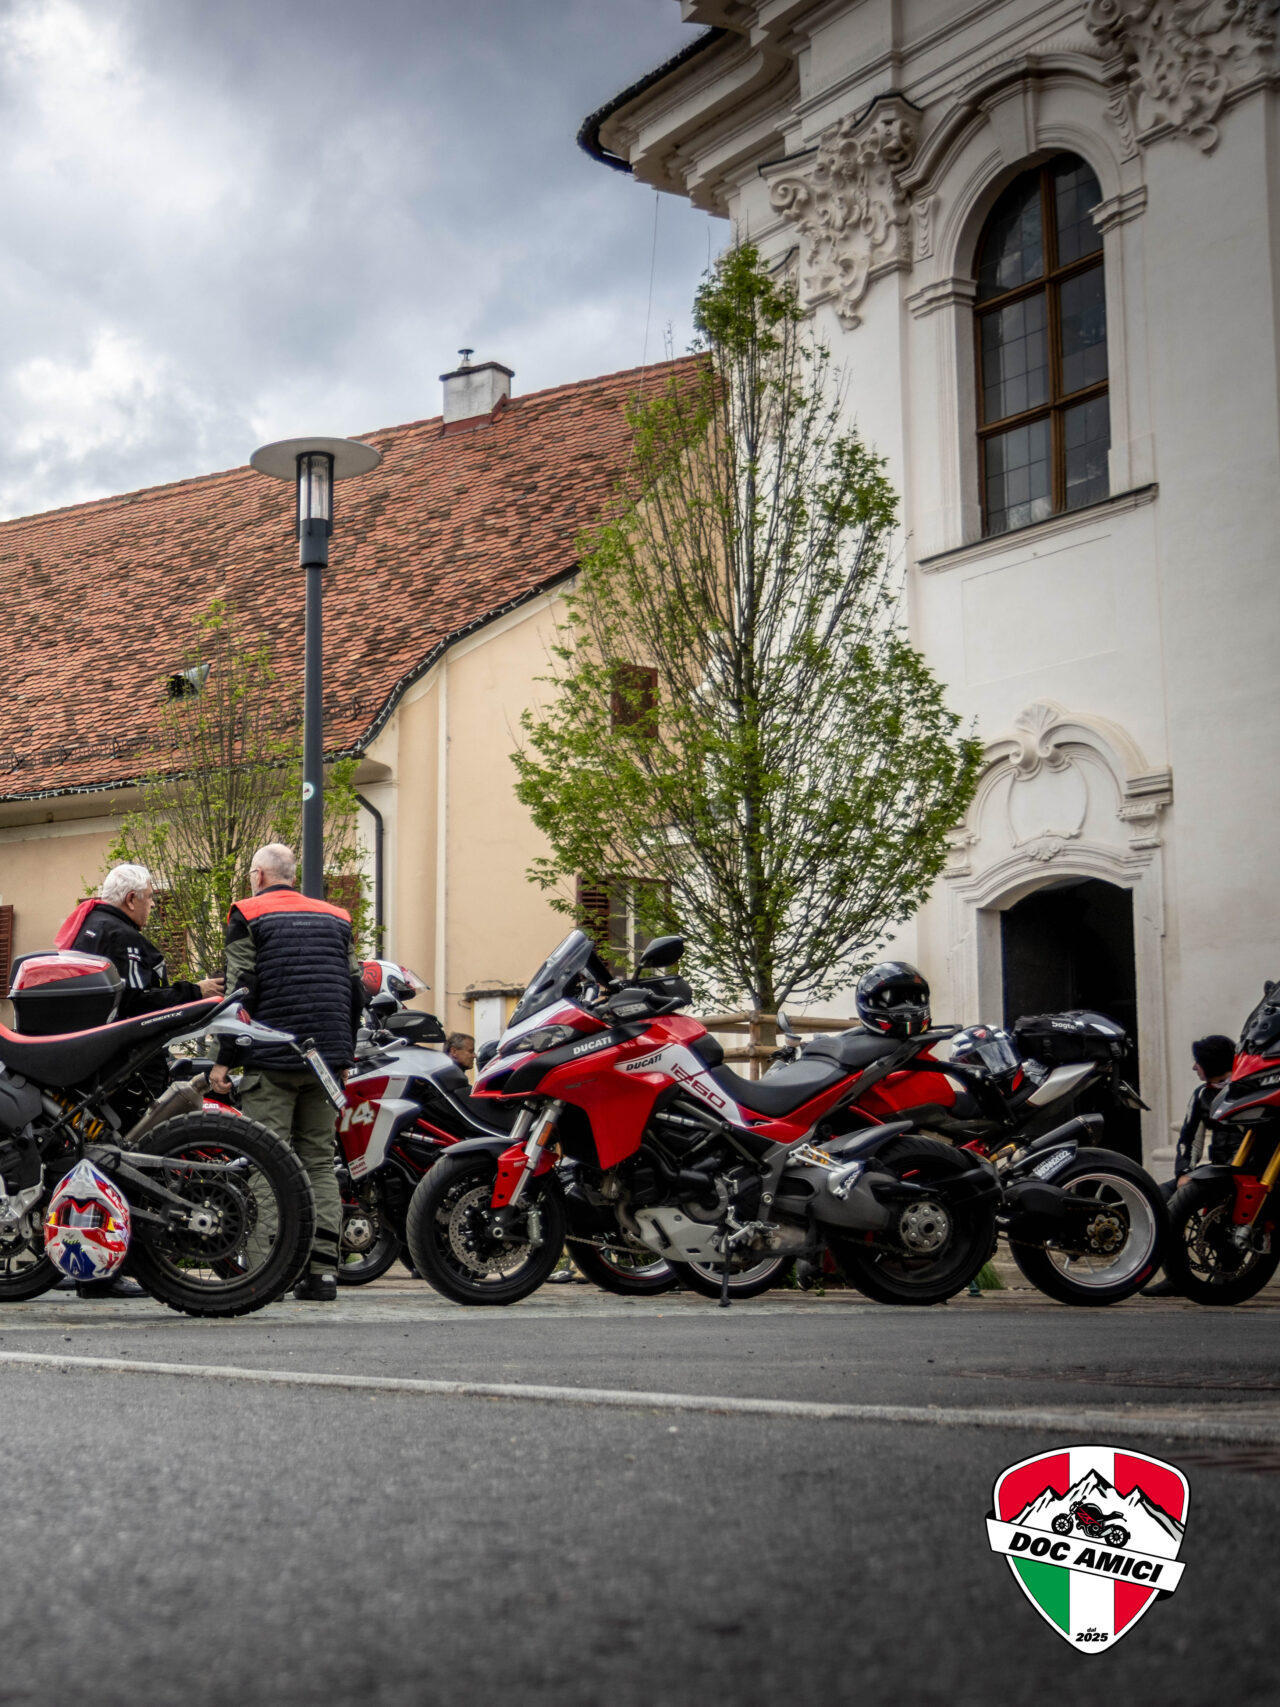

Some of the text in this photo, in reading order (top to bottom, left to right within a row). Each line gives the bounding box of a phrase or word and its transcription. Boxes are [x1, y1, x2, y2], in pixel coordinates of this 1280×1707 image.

[573, 1036, 612, 1055] DUCATI
[626, 1053, 662, 1072] DUCATI
[670, 1063, 726, 1109] 1260
[340, 1100, 375, 1133] 14
